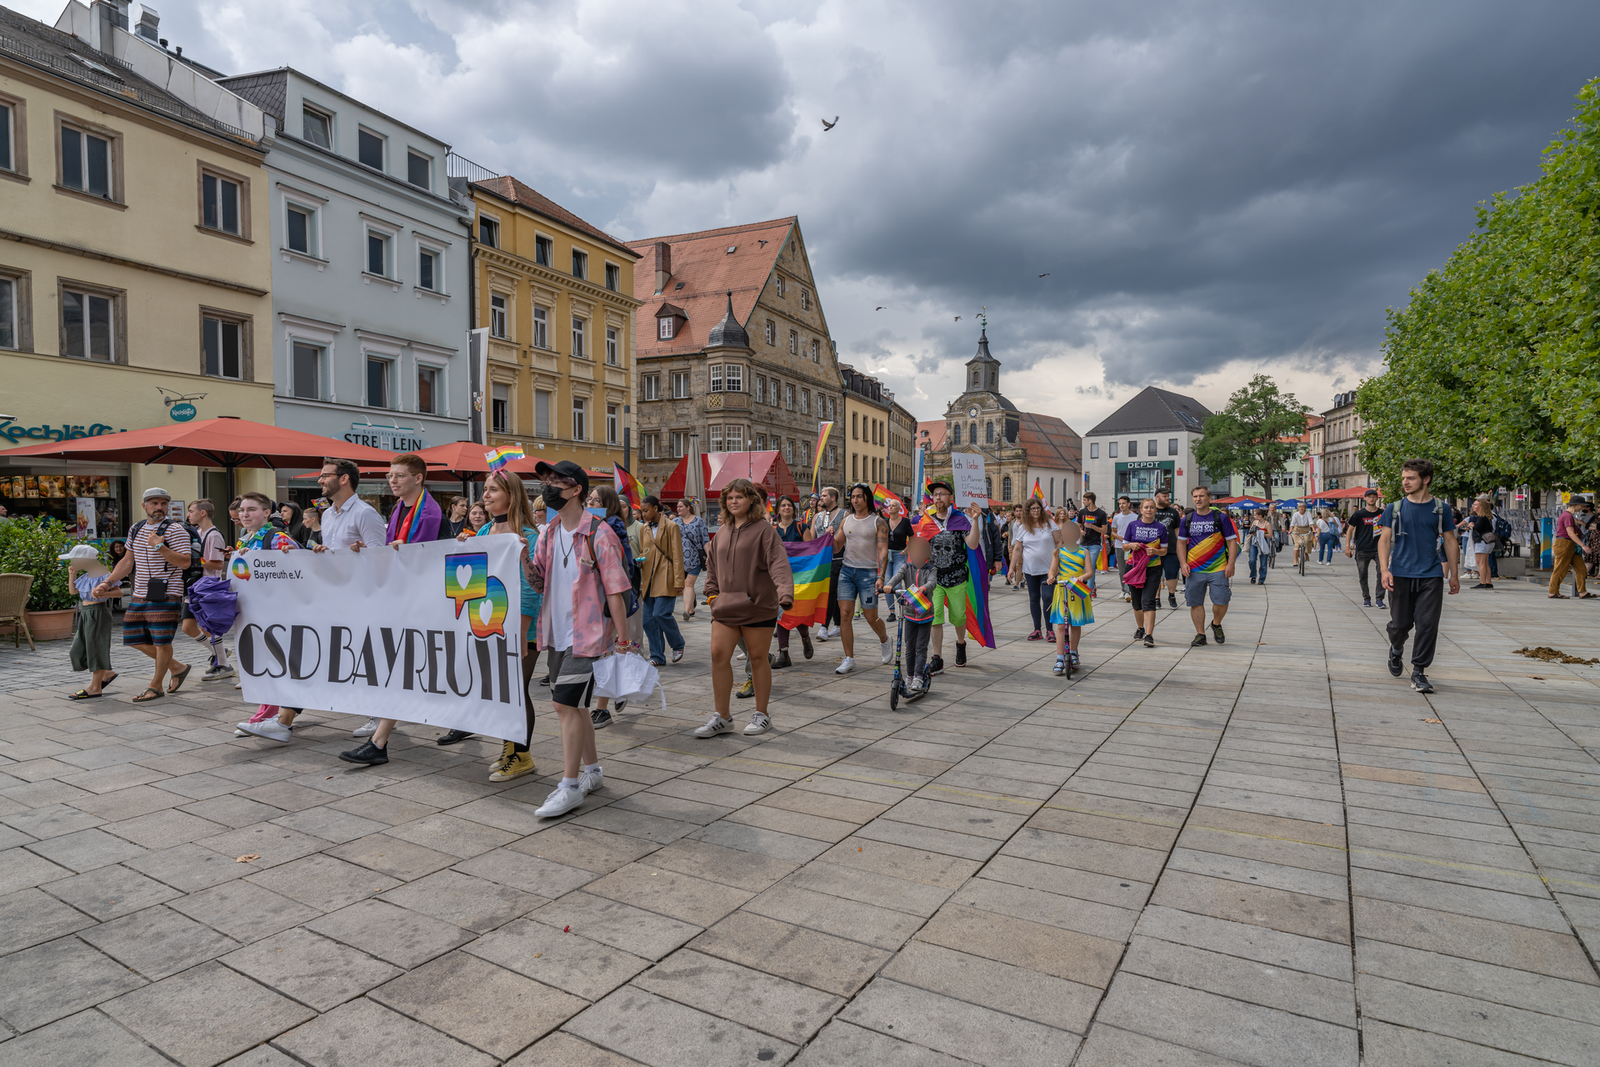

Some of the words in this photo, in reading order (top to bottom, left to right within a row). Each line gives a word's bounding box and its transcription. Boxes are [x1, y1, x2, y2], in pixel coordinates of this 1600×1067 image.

[344, 433, 422, 452] STREHLEIN
[953, 458, 963, 470] Ich
[253, 558, 277, 568] Queer
[253, 570, 288, 581] Bayreuth
[289, 570, 303, 580] e.V.
[238, 623, 321, 680] CSD
[328, 624, 522, 707] BAYREUTH
